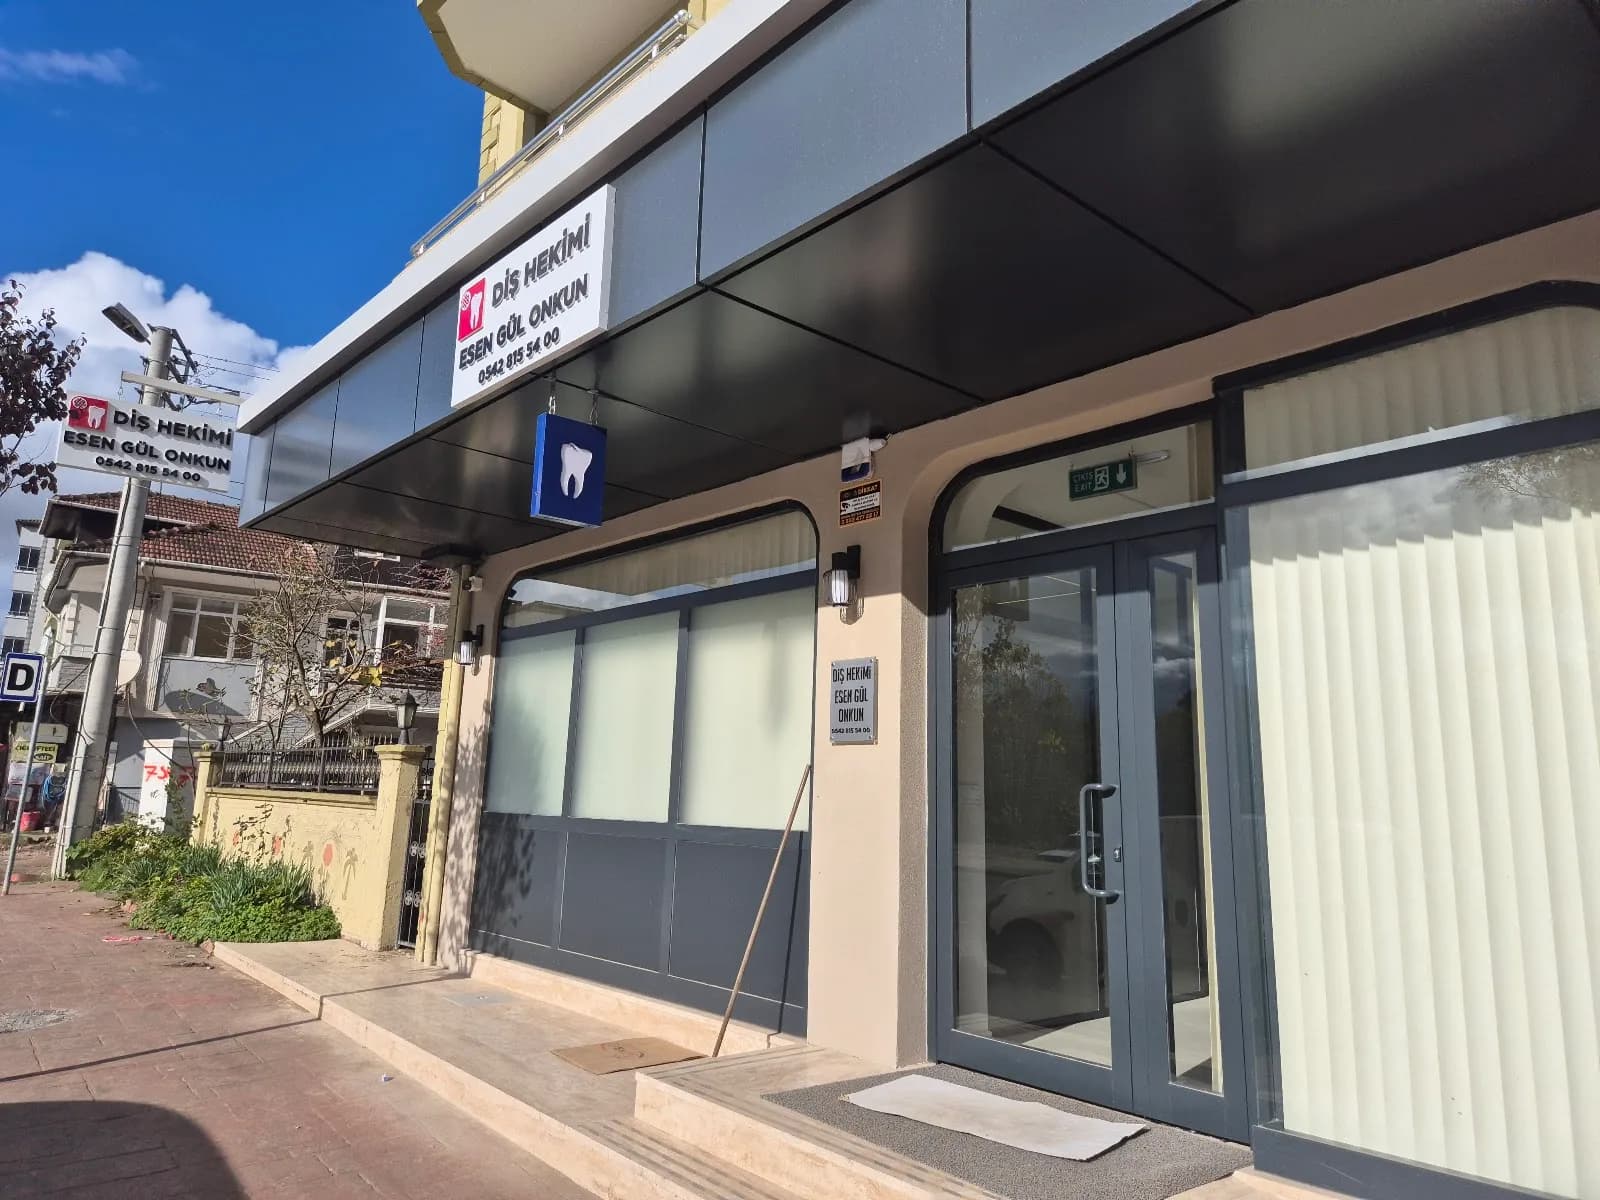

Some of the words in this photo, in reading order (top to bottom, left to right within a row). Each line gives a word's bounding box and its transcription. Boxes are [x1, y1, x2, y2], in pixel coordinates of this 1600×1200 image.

[492, 267, 521, 307] DİŞ
[524, 212, 591, 285] HEKİMİ
[458, 333, 494, 369] ESEN
[496, 313, 526, 348] GÜL
[528, 273, 589, 328] ONKUN
[478, 359, 505, 384] 0542
[505, 348, 524, 369] 815
[526, 336, 542, 356] 54
[543, 326, 560, 345] 00
[113, 409, 151, 431] DİŞ
[157, 419, 233, 447] HEKİMİ
[63, 430, 116, 451] ESEN
[121, 440, 159, 459] GÜL
[164, 449, 232, 472] ONKUN
[95, 456, 132, 471] 0542
[135, 463, 158, 474] 815
[162, 467, 178, 479] 54
[182, 471, 201, 482] 00
[7, 663, 35, 691] D
[832, 668, 845, 684] DİŞ
[846, 665, 872, 682] HEKİMİ
[834, 689, 853, 704] ESEN
[854, 685, 868, 703] GÜL
[838, 708, 864, 722] ONKUN
